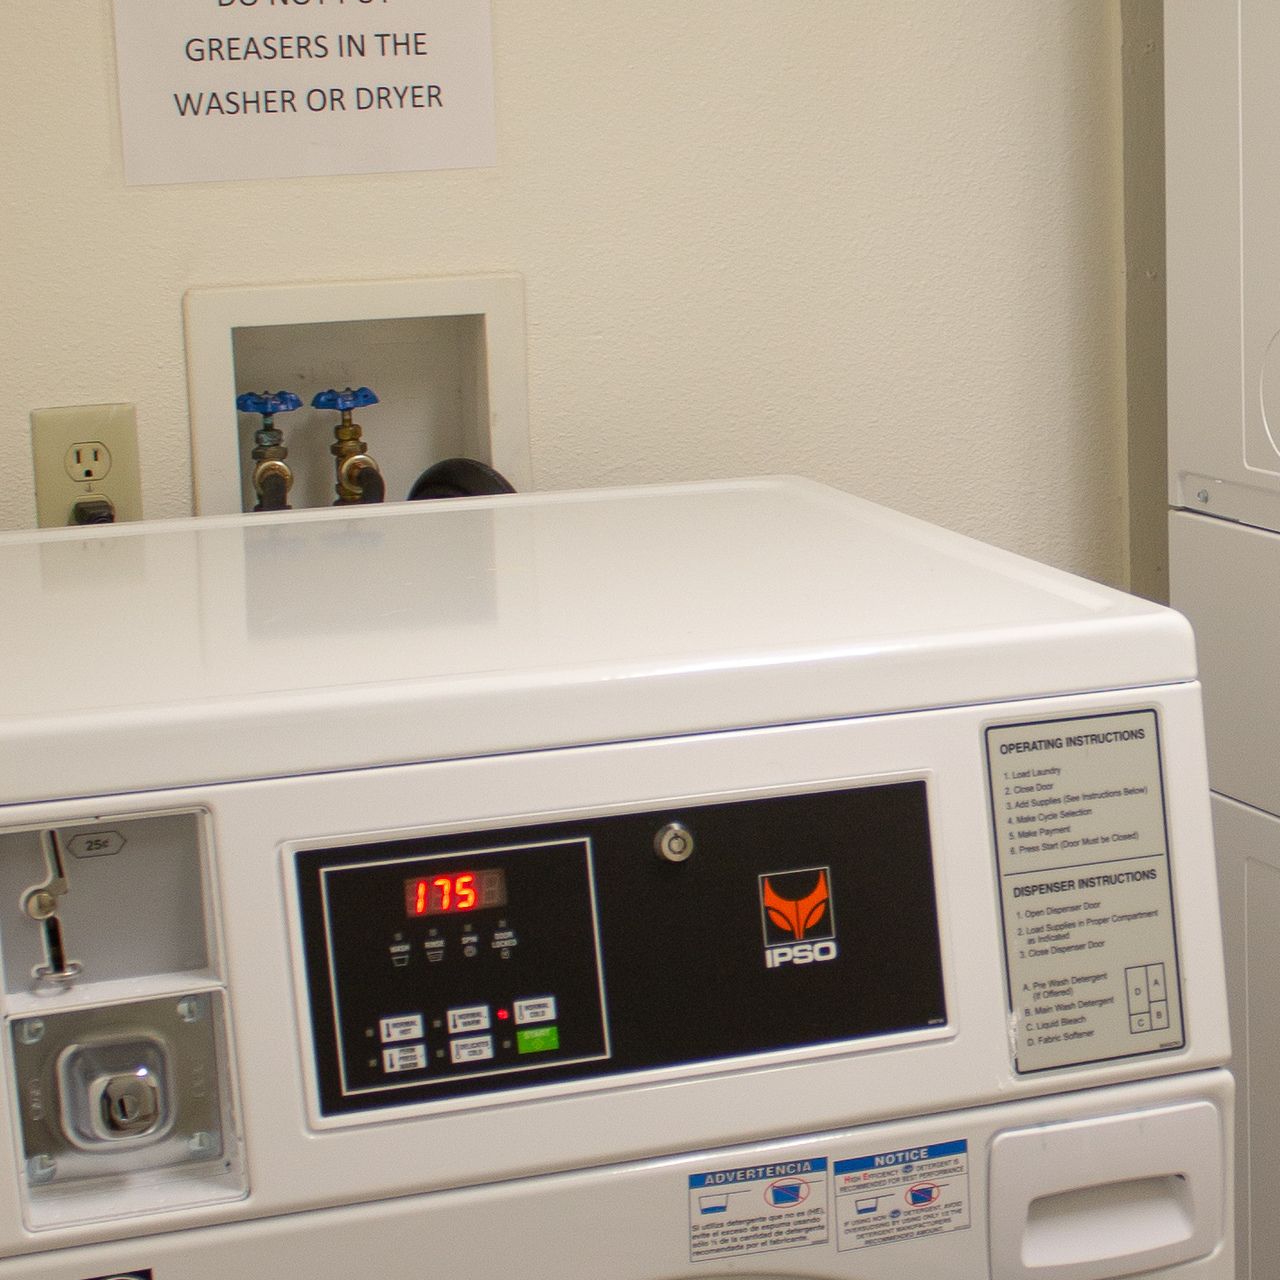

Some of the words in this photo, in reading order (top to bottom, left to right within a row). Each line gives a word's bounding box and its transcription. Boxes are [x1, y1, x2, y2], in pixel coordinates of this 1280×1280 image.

[185, 35, 329, 62] GREASERS
[338, 34, 366, 58] IN
[374, 32, 428, 56] THE
[174, 90, 298, 117] WASHER
[306, 88, 346, 112] OR
[356, 84, 444, 110] DRYER
[999, 738, 1062, 755] OPERATING
[1065, 728, 1145, 748] INSTRUCTIONS
[1011, 770, 1031, 779] Load
[1031, 767, 1061, 779] Laundry
[1013, 785, 1034, 794] Close
[1035, 783, 1053, 792] Door
[1014, 800, 1029, 808] Add
[1030, 796, 1061, 808] Supplies
[1062, 794, 1080, 805] (See
[1081, 789, 1121, 801] Instructions
[1122, 786, 1148, 798] Below)
[1015, 814, 1036, 823] Make
[1037, 812, 1058, 823] Cycle
[1059, 808, 1092, 819] Selection
[1017, 829, 1037, 839] Make
[1038, 826, 1071, 838] Payment
[1018, 844, 1039, 853] Press
[1040, 842, 1059, 851] Start
[1059, 839, 1079, 850] (Door
[1081, 837, 1099, 846] Must
[1100, 836, 1110, 844] be
[1111, 832, 1139, 844] Closed)
[1013, 880, 1075, 898] DISPENSER
[1077, 869, 1157, 890] INSTRUCTIONS
[415, 872, 477, 914] 175
[1024, 908, 1045, 920] Open
[1045, 904, 1082, 917] Dispenser
[1082, 901, 1100, 910] Door
[1025, 925, 1044, 935] Load
[1045, 921, 1076, 934] Supplies
[1077, 920, 1084, 928] in
[1085, 917, 1109, 929] Proper
[1111, 910, 1158, 925] Compartment
[1037, 932, 1070, 943] Indicated
[765, 941, 838, 969] IPSO
[1027, 948, 1049, 957] Close
[1049, 943, 1086, 956] Dispenser
[1087, 941, 1104, 950] Door
[1032, 981, 1046, 990] Pre
[1047, 978, 1069, 988] Wash
[1070, 973, 1107, 987] Detergent
[1134, 987, 1141, 996] D
[1153, 978, 1160, 987] A
[1034, 1005, 1053, 1015] Main
[1054, 1002, 1076, 1012] Wash
[1077, 997, 1114, 1011] Detergent
[1035, 1019, 1059, 1031] Liquid
[1060, 1015, 1086, 1026] Bleach
[1137, 1019, 1145, 1028] C
[1156, 1011, 1163, 1019] B
[1037, 1034, 1061, 1045] Fabric
[1062, 1030, 1094, 1041] Softener
[876, 1148, 929, 1167] NOTICE
[704, 1161, 812, 1184] ADVERTENCIA
[918, 1167, 963, 1179] PERFORMANCE
[691, 1231, 710, 1239] evite
[760, 1222, 791, 1232] espuma
[792, 1217, 820, 1226] usando
[725, 1216, 767, 1228] detergente
[739, 1232, 772, 1242] cantidad
[784, 1225, 825, 1237] detergente
